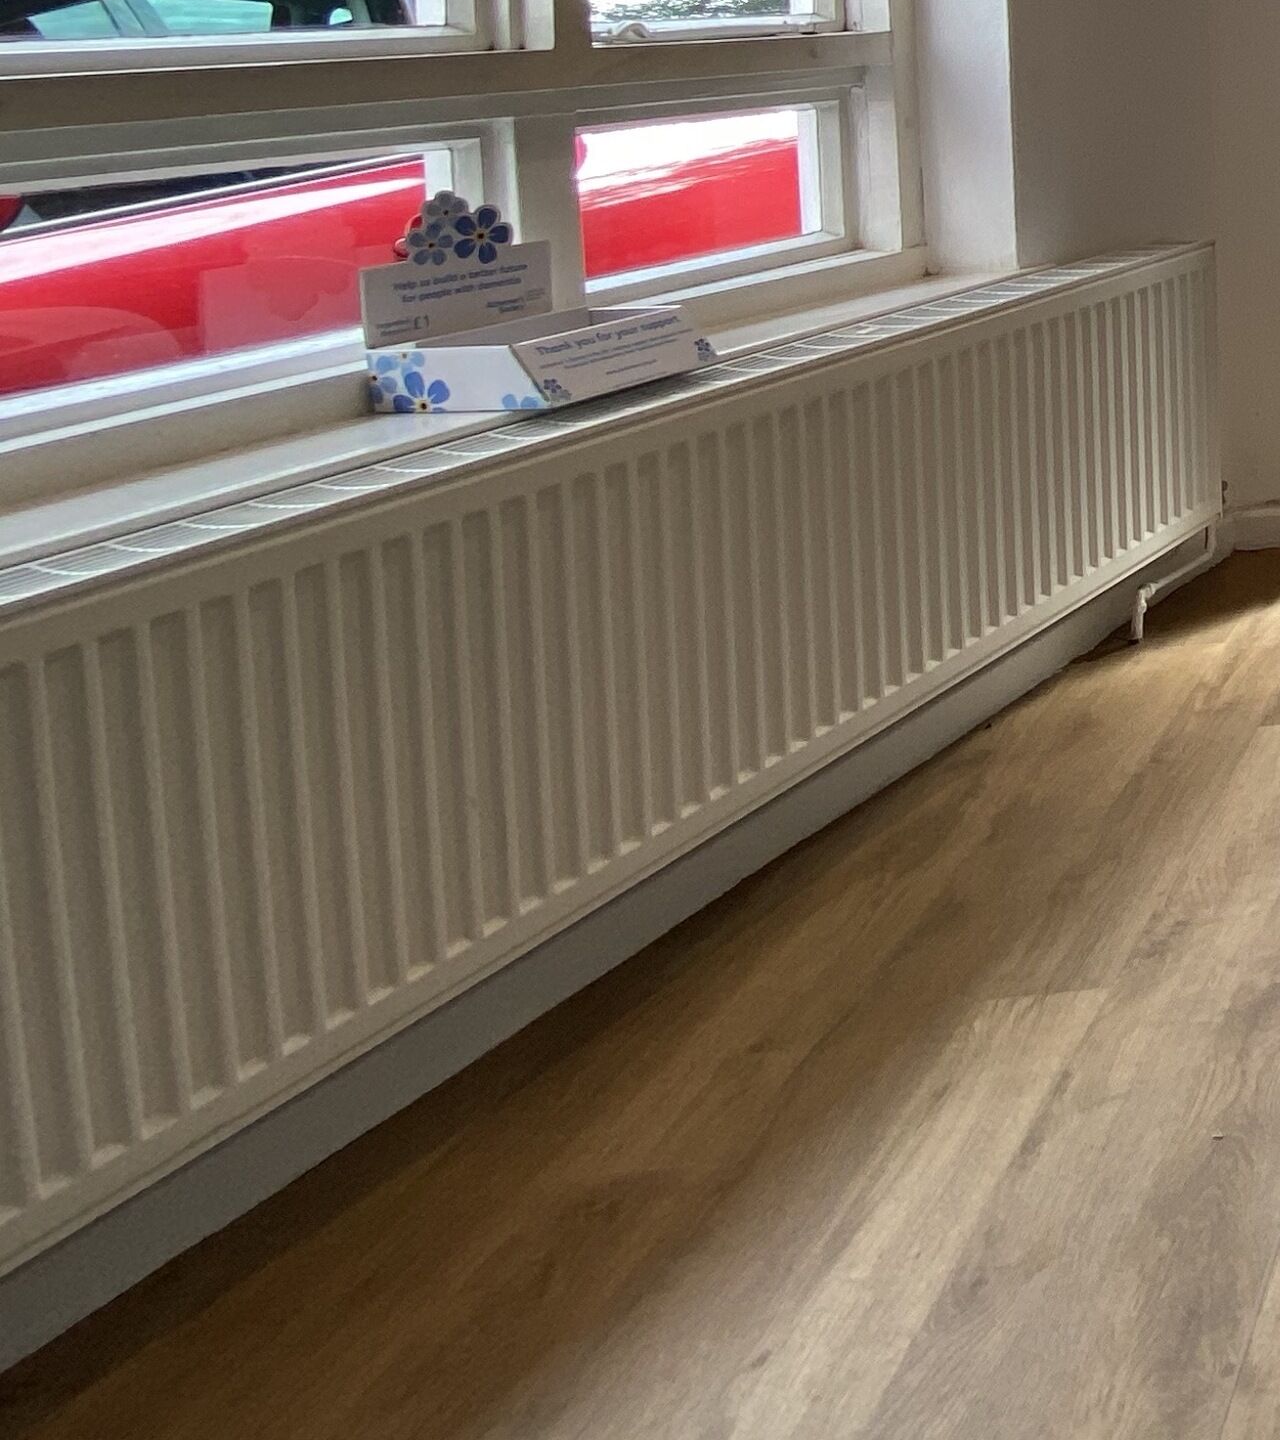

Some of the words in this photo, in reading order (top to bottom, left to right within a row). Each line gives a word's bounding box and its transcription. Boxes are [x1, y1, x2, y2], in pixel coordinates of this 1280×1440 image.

[413, 315, 430, 330] £1
[535, 340, 572, 355] Thank
[574, 337, 596, 350] you
